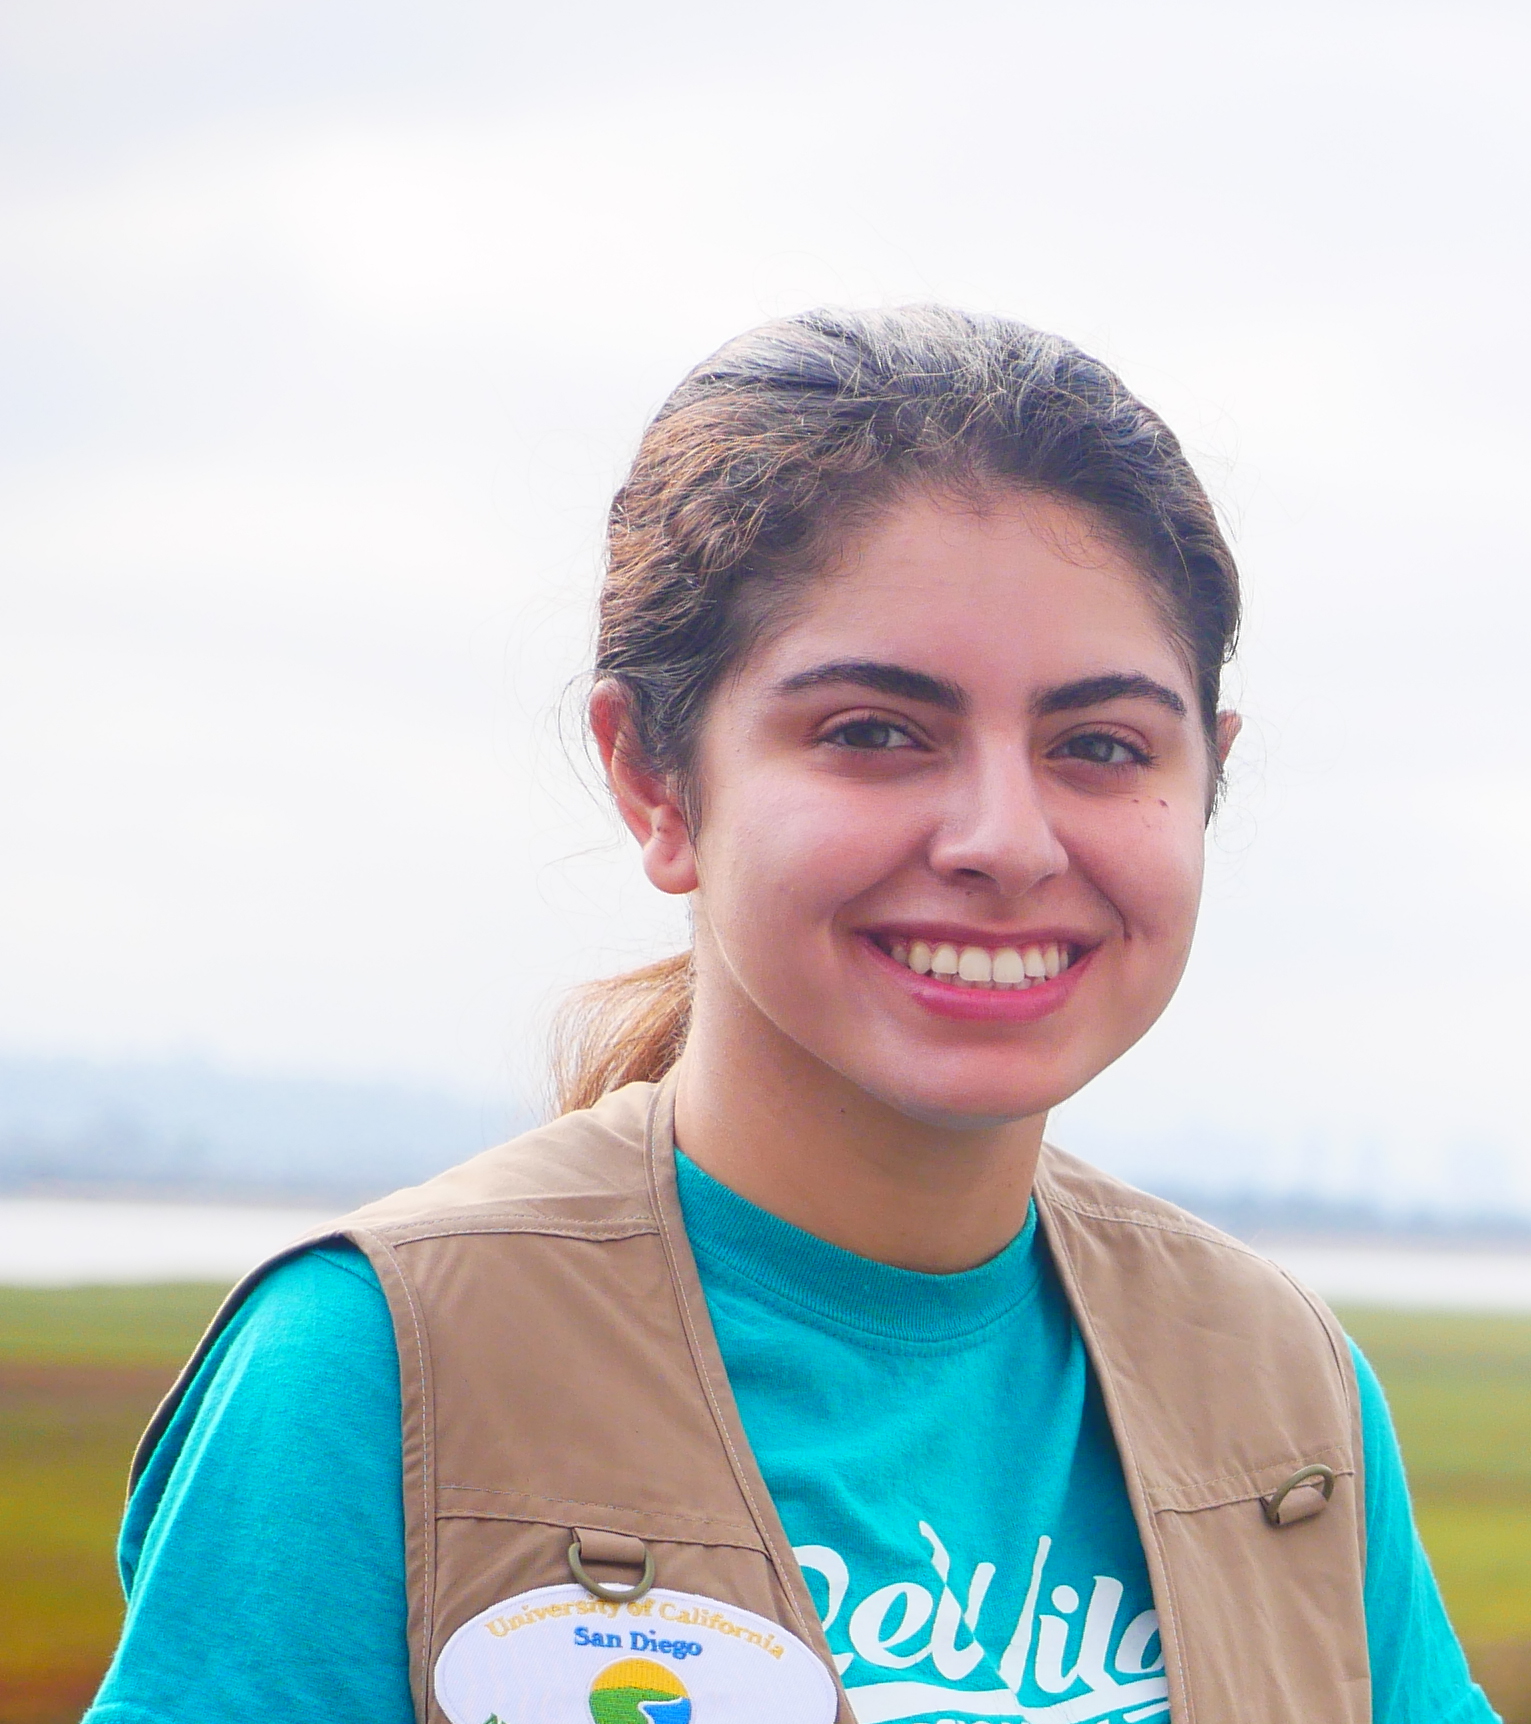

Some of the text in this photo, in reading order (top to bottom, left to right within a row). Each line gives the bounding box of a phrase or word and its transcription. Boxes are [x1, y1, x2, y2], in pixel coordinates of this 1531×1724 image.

[484, 1595, 786, 1660] University of California
[573, 1626, 704, 1660] San Diego
